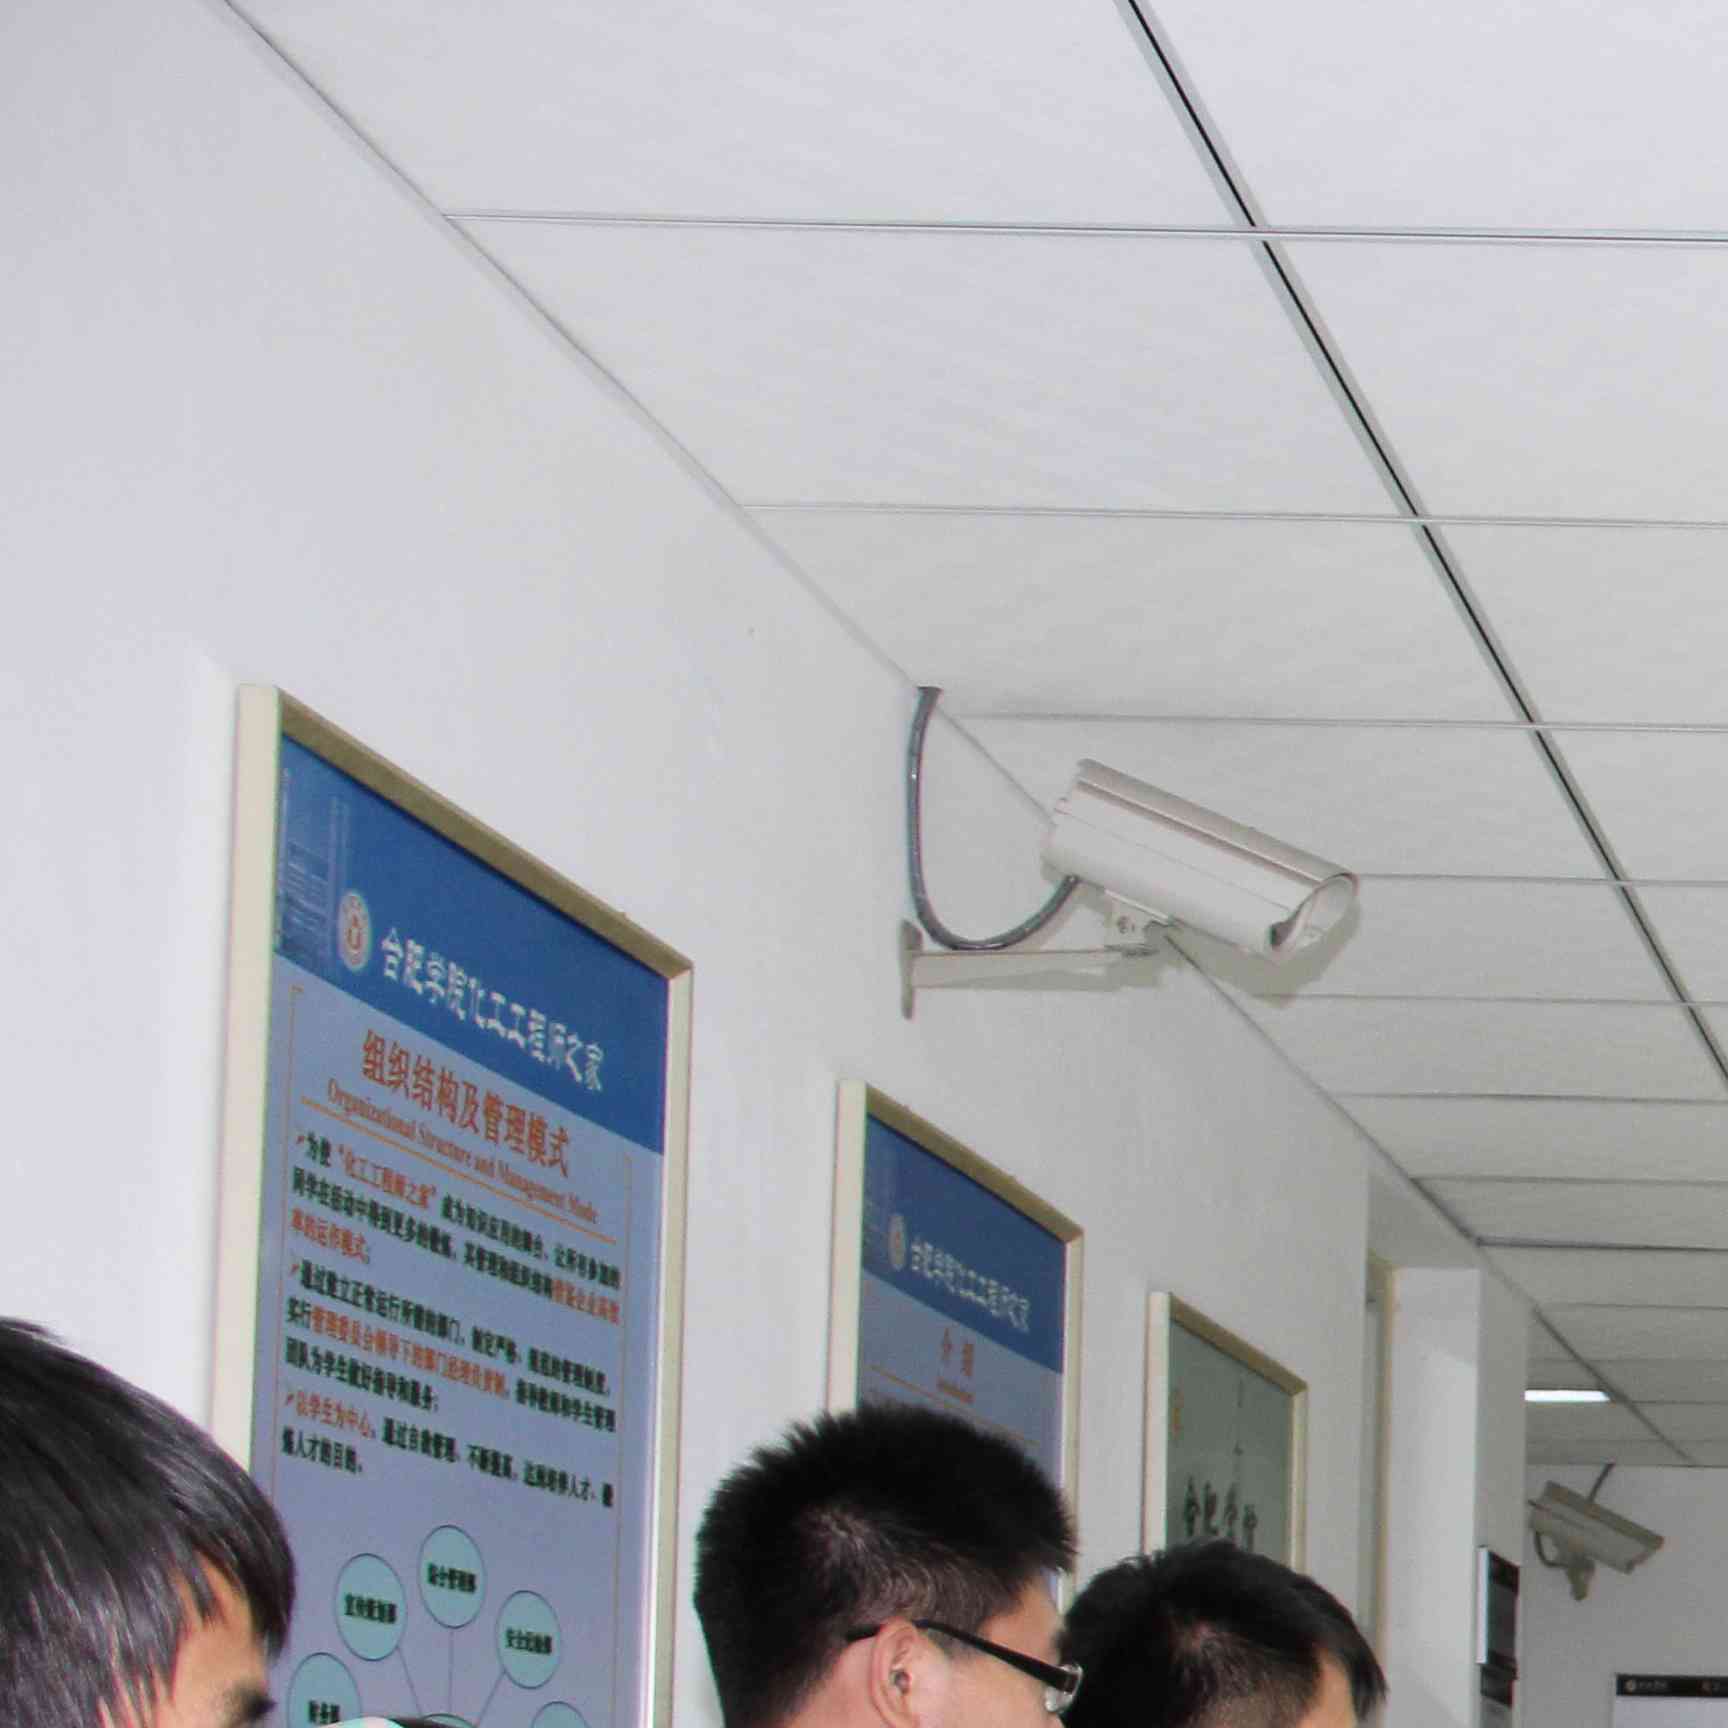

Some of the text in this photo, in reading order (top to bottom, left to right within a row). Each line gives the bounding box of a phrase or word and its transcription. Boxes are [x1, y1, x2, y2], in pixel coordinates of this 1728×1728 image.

[382, 926, 604, 1092] 合肥学院化工工程师之家
[361, 1028, 570, 1178] 组织结构及管理模式
